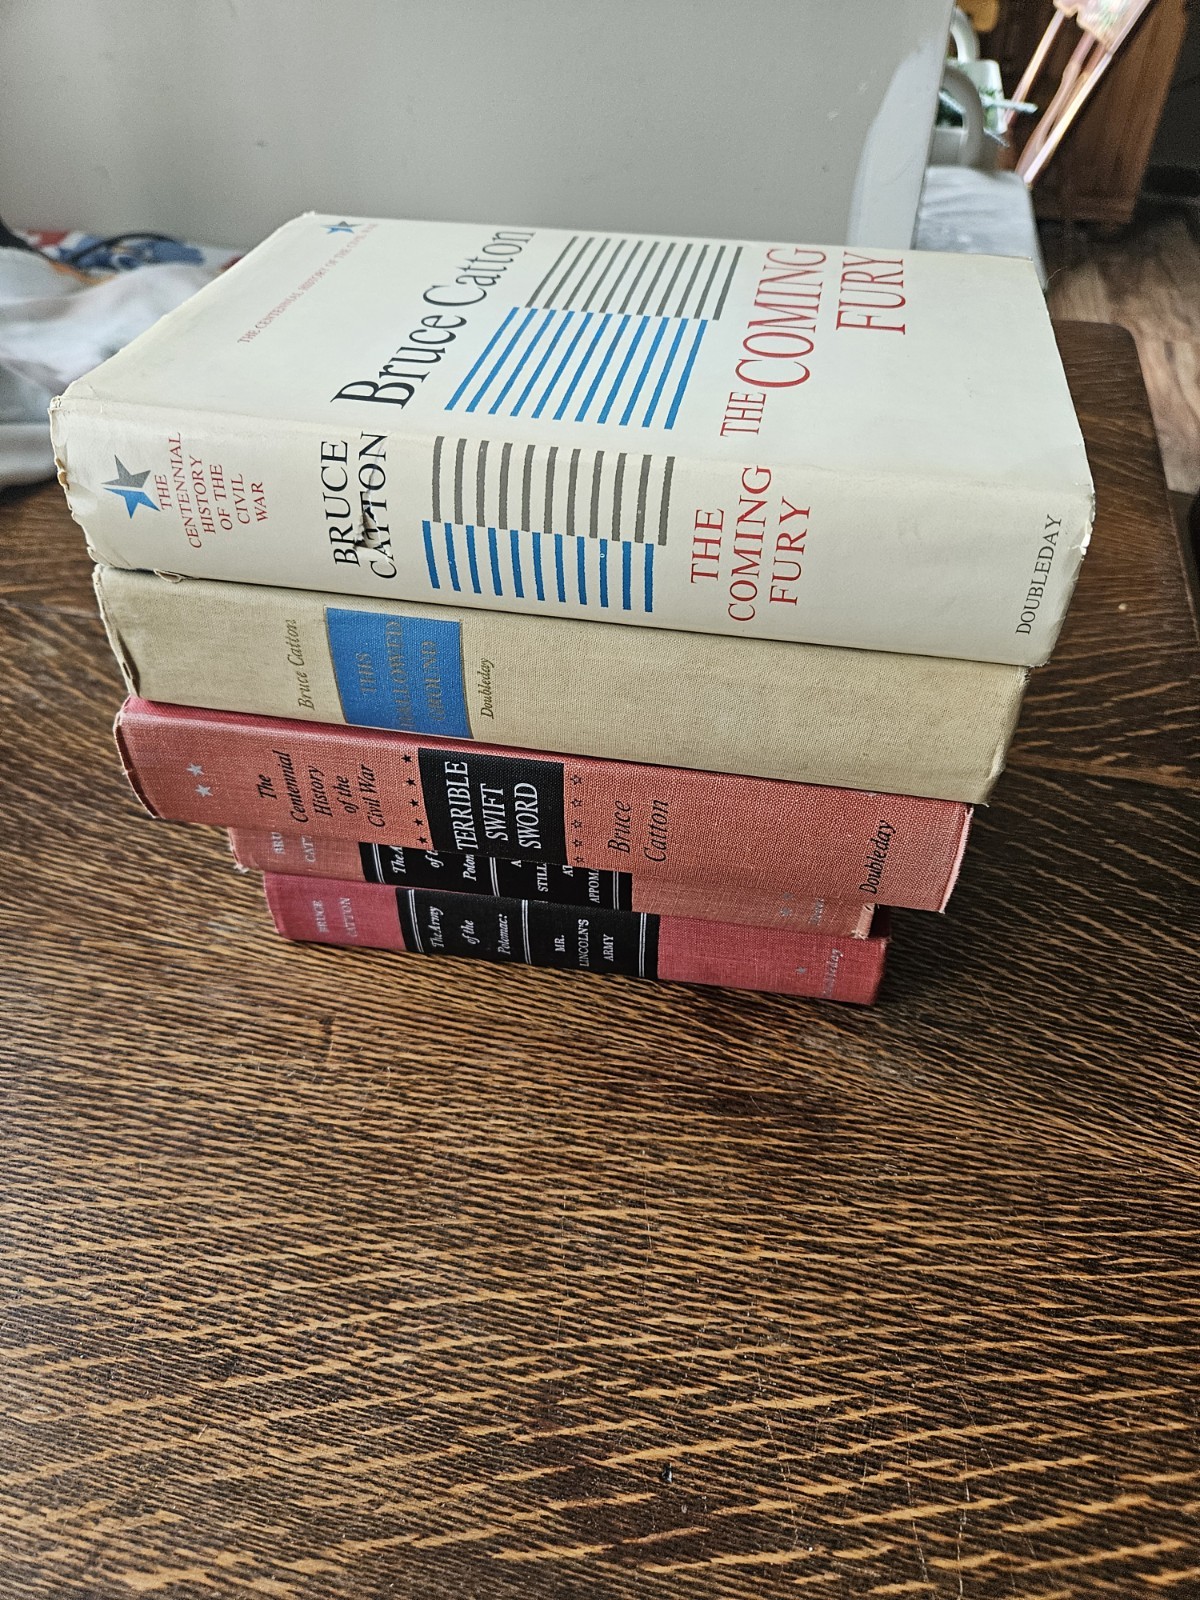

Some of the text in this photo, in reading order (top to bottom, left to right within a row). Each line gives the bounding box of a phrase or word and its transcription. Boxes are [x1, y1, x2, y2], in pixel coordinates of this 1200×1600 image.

[330, 231, 536, 409] Bruce Catton
[836, 251, 906, 335] FURY
[719, 248, 827, 437] THE COMING
[155, 474, 173, 510] THE
[168, 432, 202, 548] CENTENNIAL
[189, 455, 216, 534] HISTORY
[209, 464, 233, 530] OF THE
[231, 473, 251, 524] CIVIL
[251, 481, 269, 521] WAR
[320, 440, 360, 567] BRUCE
[690, 507, 725, 584] THE
[728, 465, 772, 621] COMING
[769, 496, 811, 605] FURY
[1015, 513, 1062, 635] DOUBLEDAY
[285, 619, 315, 711] Bruce Catton
[476, 657, 495, 719] Doubleday
[256, 774, 278, 800] The
[272, 749, 309, 823] Centennial
[308, 765, 333, 817] History
[332, 775, 359, 814] of the
[358, 764, 386, 827] Civil War
[444, 761, 479, 850] TERRIBLE
[480, 783, 508, 841] SWIFT
[514, 782, 542, 850] SWORD
[271, 831, 285, 854] BRU
[607, 800, 632, 854] Bruce
[643, 799, 669, 863] Catton
[859, 819, 897, 895] Doubleday
[537, 862, 548, 892] STILL
[555, 934, 566, 952] MR.
[578, 919, 590, 967] LINCOLN'S
[602, 934, 614, 962] ARMY
